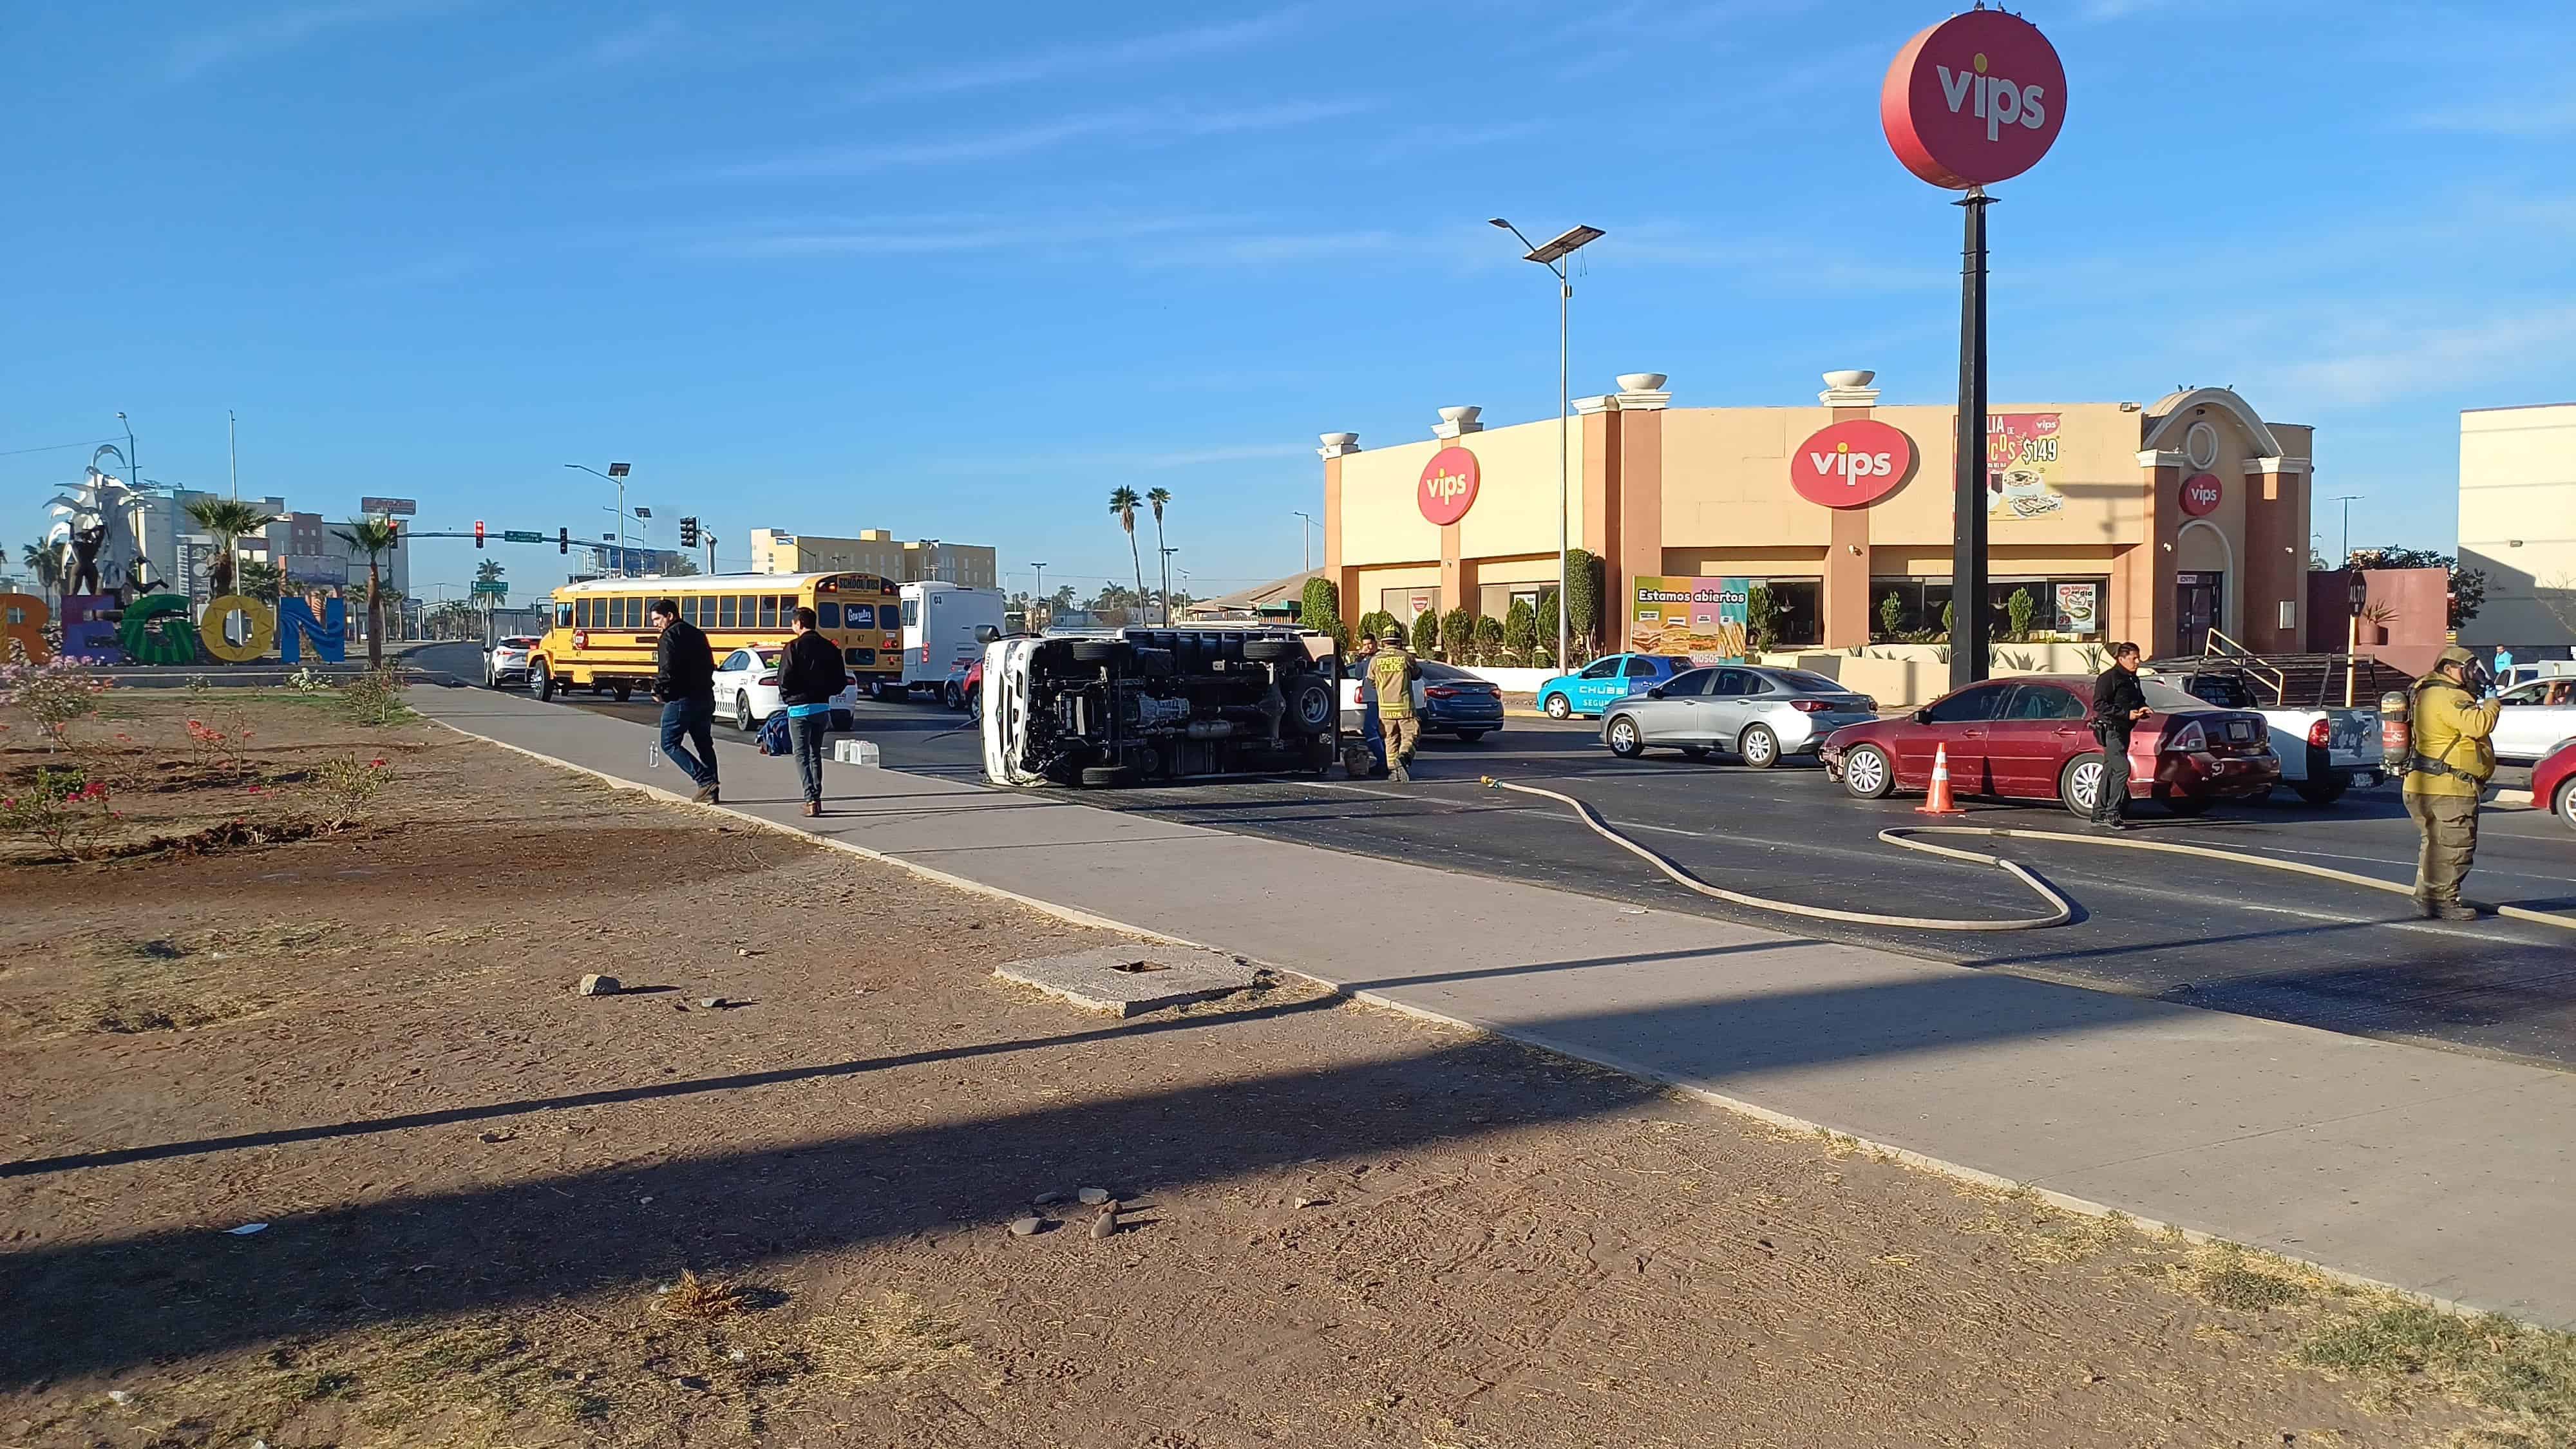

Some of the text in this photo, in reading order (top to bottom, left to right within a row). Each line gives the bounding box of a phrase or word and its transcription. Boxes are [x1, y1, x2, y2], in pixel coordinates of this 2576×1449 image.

[1937, 53, 2045, 142] vips
[2036, 420, 2056, 432] vips
[2022, 438, 2058, 464] $149
[1810, 442, 1891, 486] vips
[1426, 468, 1466, 506] vips
[2191, 484, 2217, 506] vips
[838, 578, 879, 589] SCHOOL BUS
[934, 596, 942, 604] 03
[1638, 589, 1745, 603] Estamos abiertos
[2349, 584, 2365, 602] ALTO
[1377, 657, 1405, 665] BOMBEROS
[1579, 685, 1625, 694] CHUBB
[1583, 698, 1609, 707] SEGU
